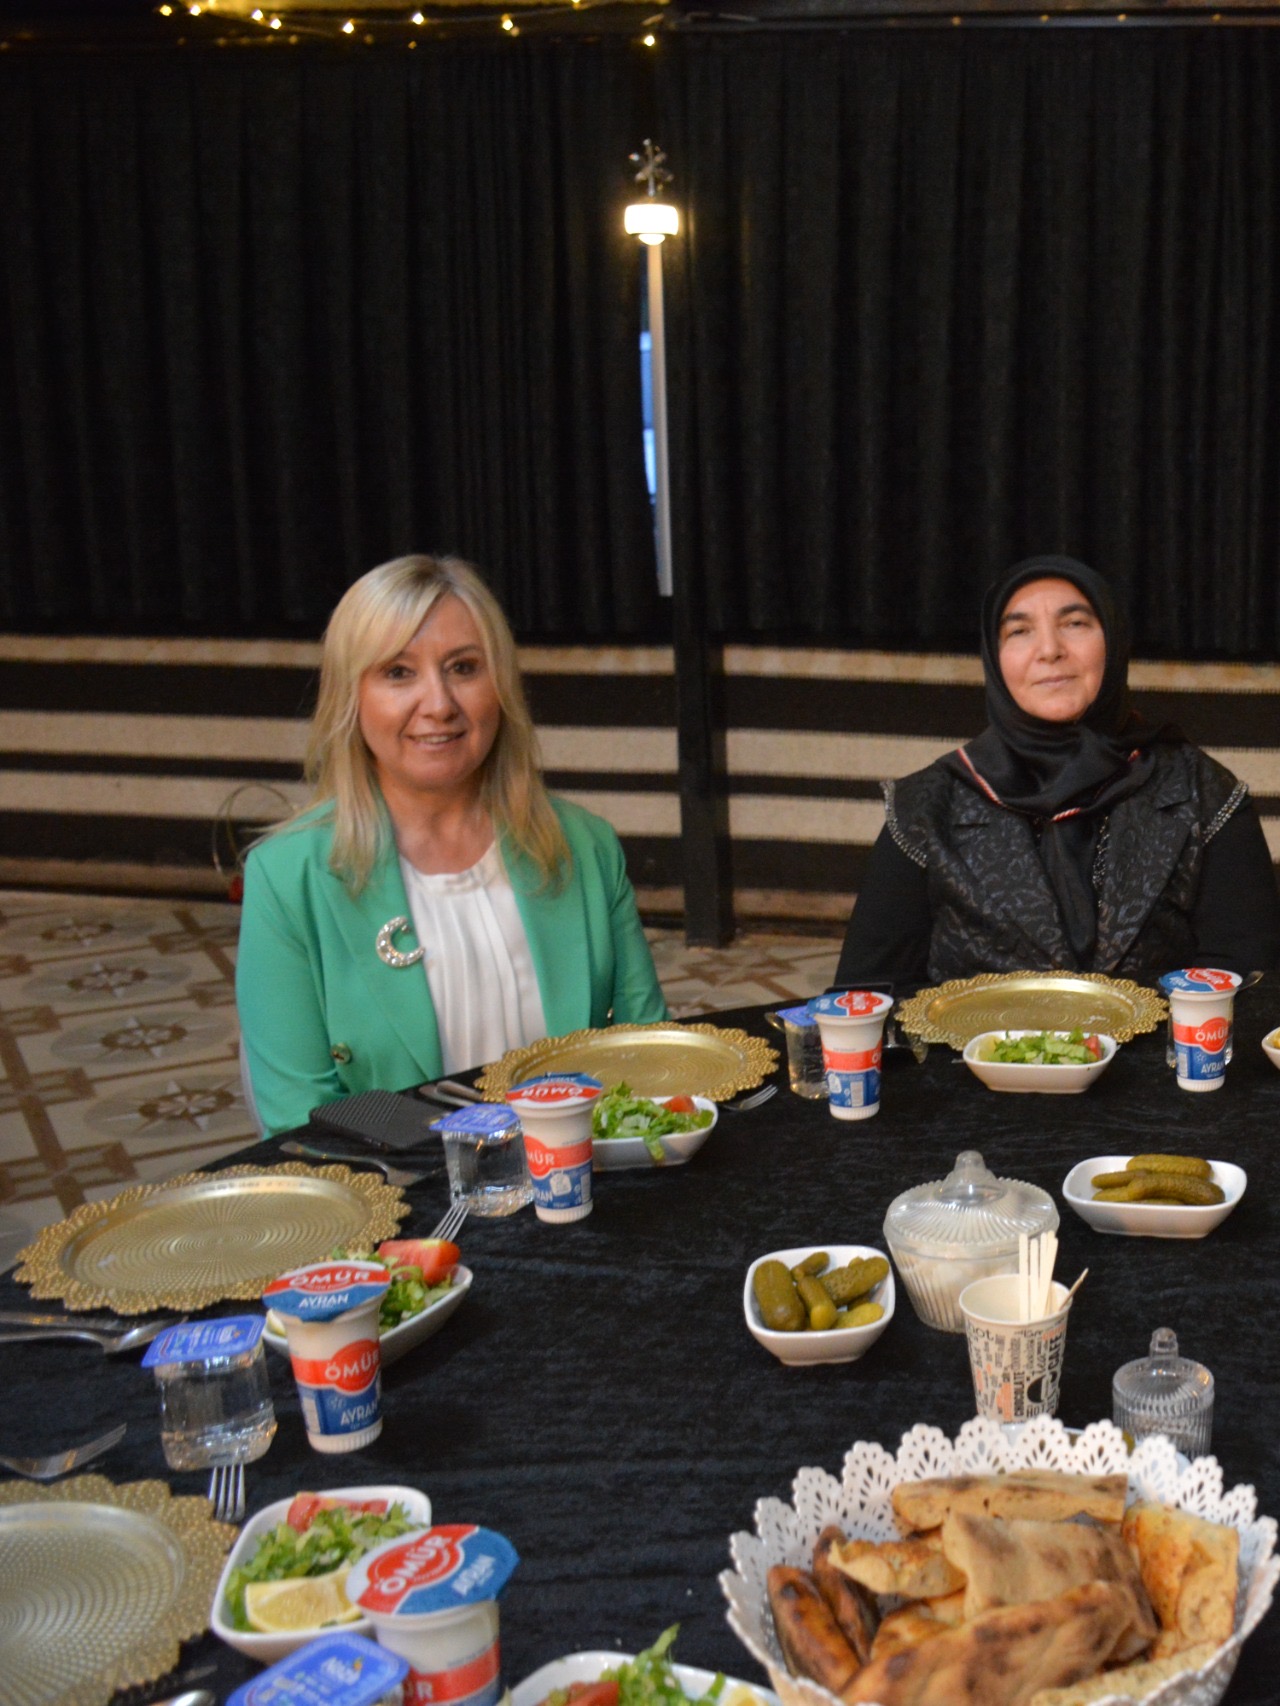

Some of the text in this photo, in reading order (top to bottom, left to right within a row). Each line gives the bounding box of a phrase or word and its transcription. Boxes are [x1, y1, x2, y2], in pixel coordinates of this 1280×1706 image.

[528, 1149, 555, 1166] MÜR
[289, 1268, 372, 1288] ÖMÜR
[299, 1293, 350, 1309] AYRAN
[1013, 1371, 1025, 1417] CHOCOLATE
[374, 1533, 453, 1595] ÖMÜR
